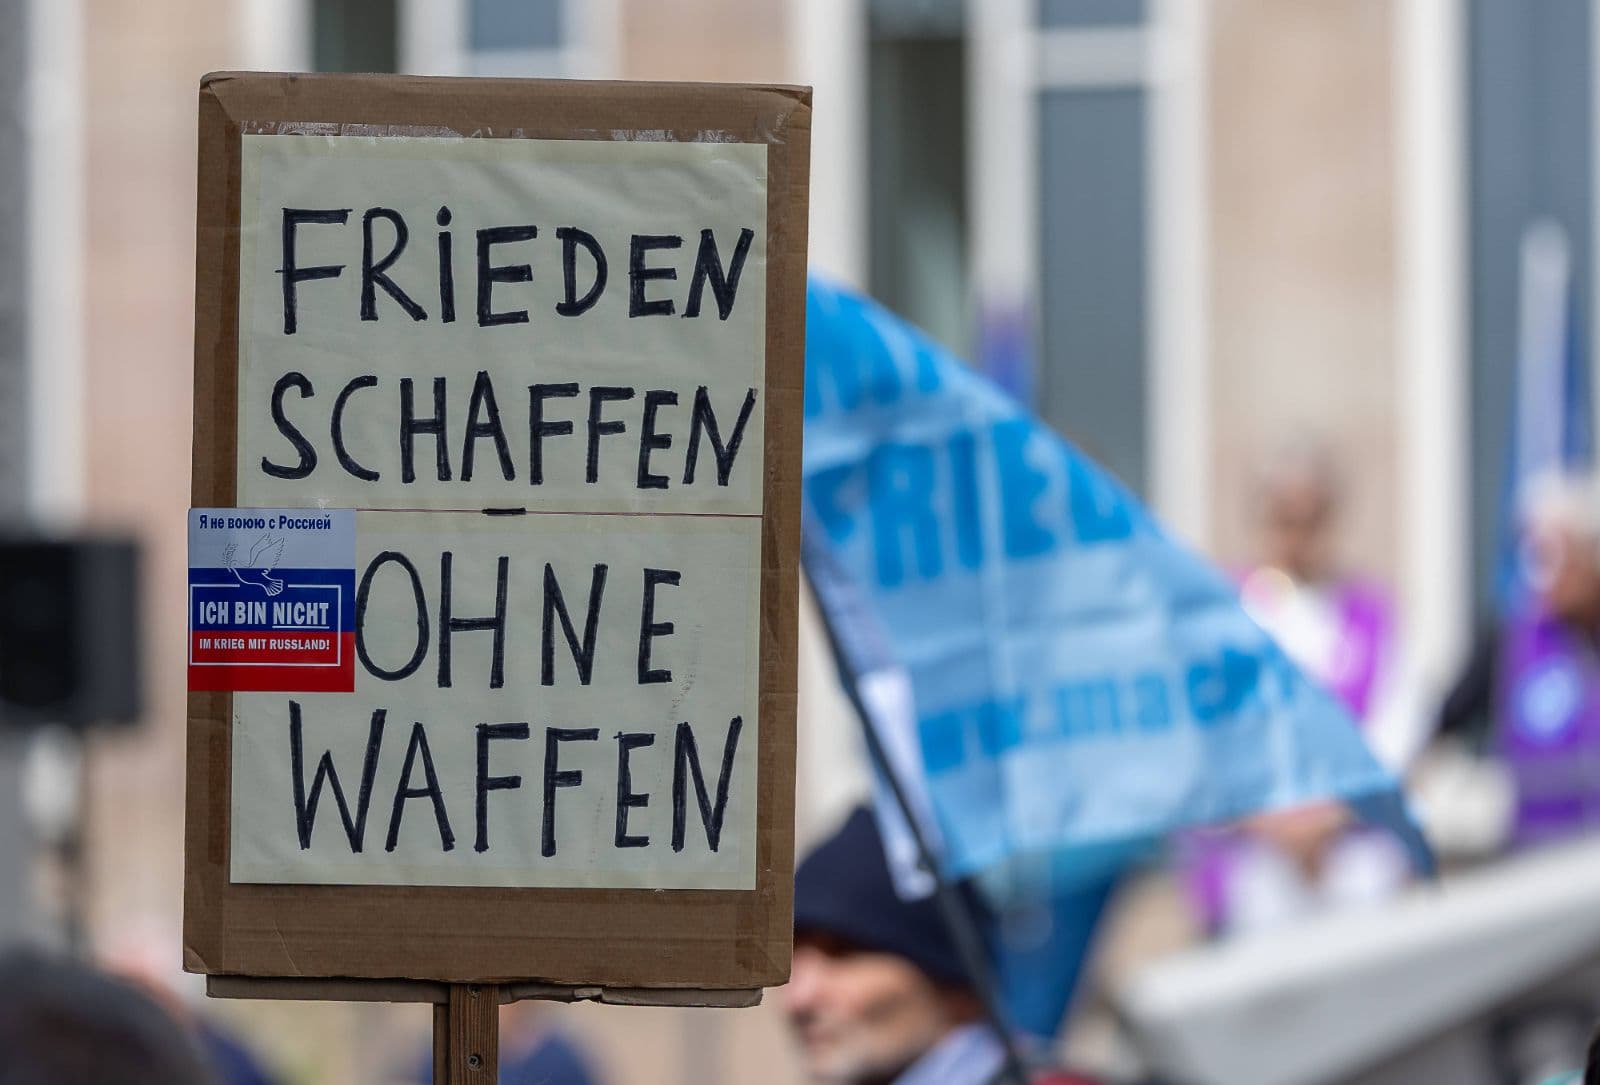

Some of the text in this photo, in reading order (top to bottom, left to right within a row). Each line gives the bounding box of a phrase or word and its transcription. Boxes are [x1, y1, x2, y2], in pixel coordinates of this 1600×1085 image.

[261, 371, 755, 489] SCHAFFEN
[199, 513, 331, 530] Я не воюю с Россией
[199, 601, 329, 625] ICH BIN NICHT
[199, 638, 330, 650] IM KRIEG MIT RUSSLAND!
[355, 551, 681, 689] OHNE
[289, 700, 742, 857] WAFFEN
